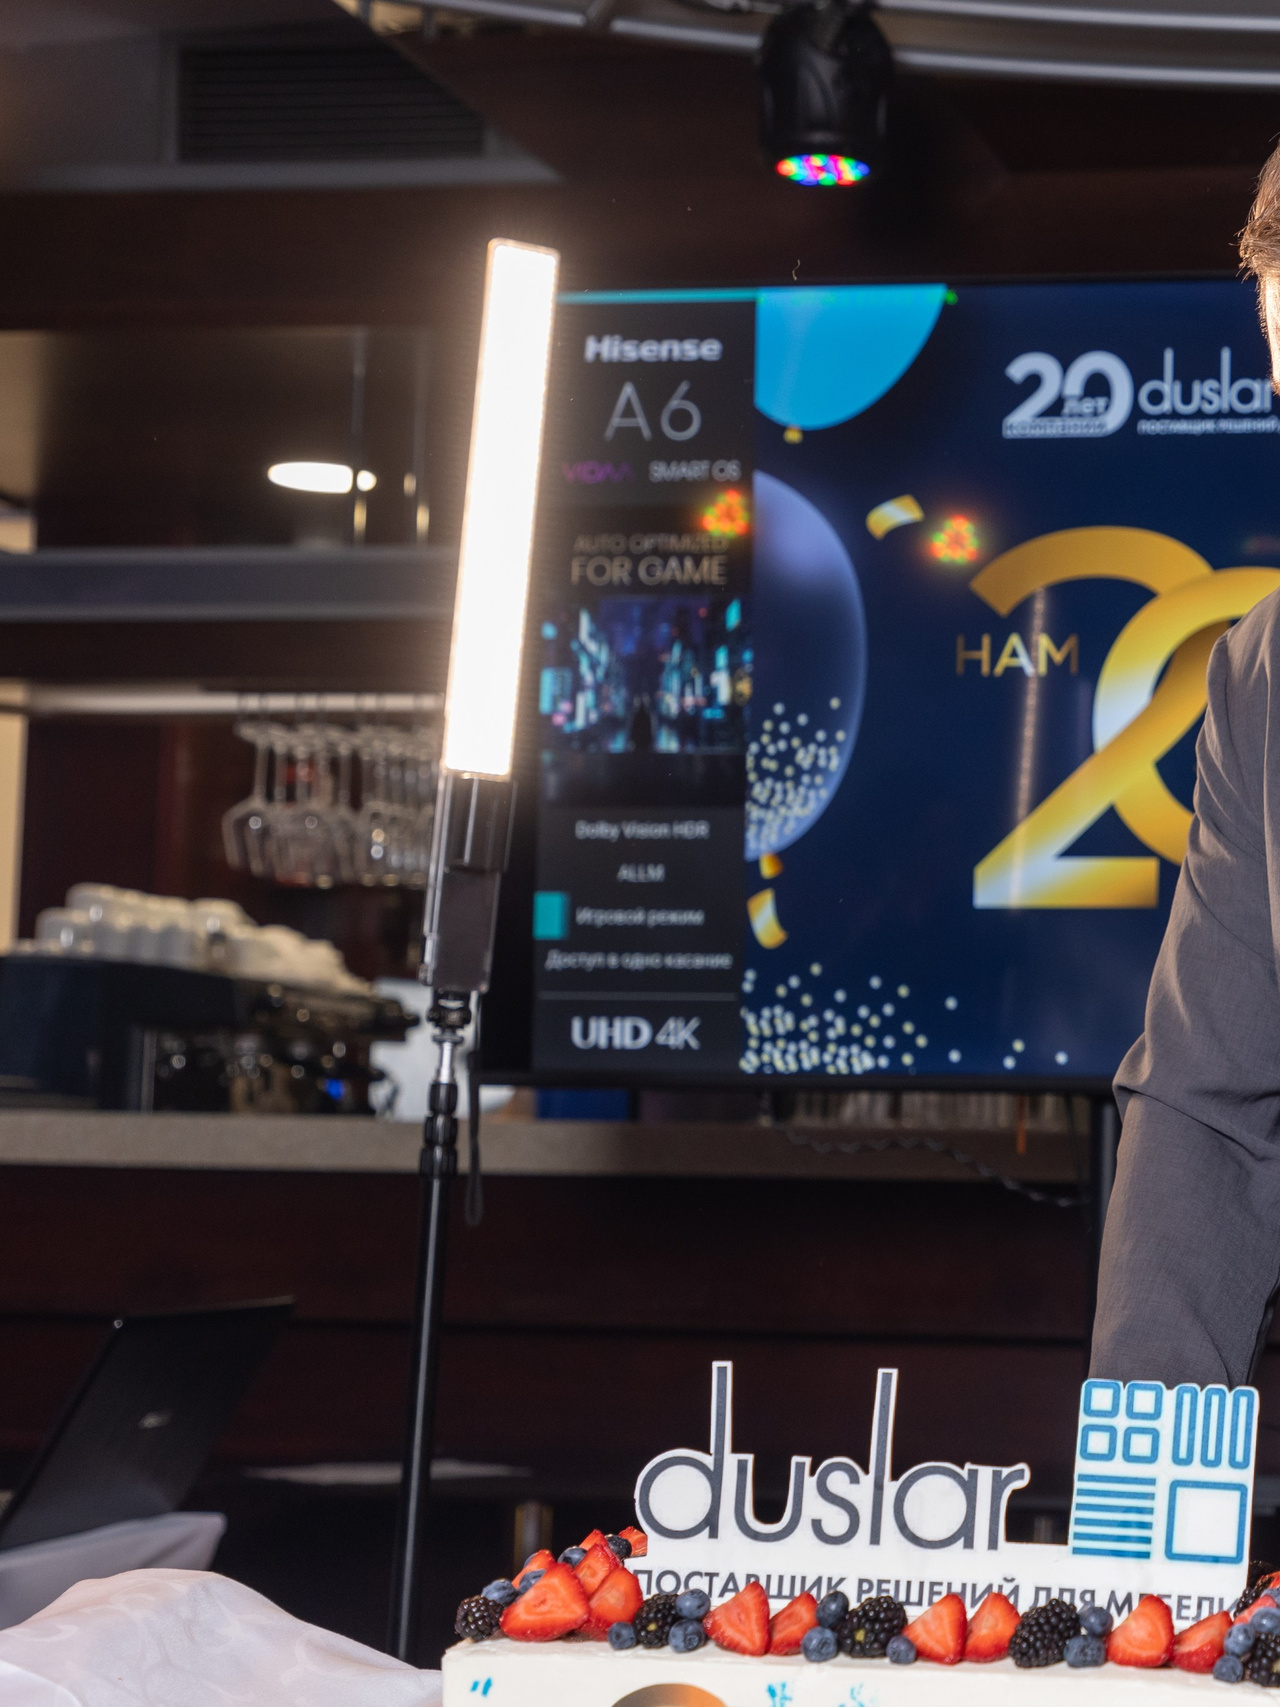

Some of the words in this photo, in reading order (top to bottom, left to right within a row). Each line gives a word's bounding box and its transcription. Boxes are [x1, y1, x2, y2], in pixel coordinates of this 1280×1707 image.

[585, 334, 723, 363] Hisense
[1004, 350, 1134, 439] 20
[1137, 347, 1274, 415] duslar
[604, 379, 702, 441] A6
[649, 459, 711, 482] SMART
[711, 459, 742, 482] OS
[573, 533, 627, 554] AUTO
[570, 555, 632, 585] FOR
[637, 555, 728, 585] GAME
[956, 633, 1079, 677] НАМ
[575, 820, 620, 842] Dolby
[620, 820, 671, 839] Vision
[672, 820, 711, 839] HDR
[616, 863, 665, 882] ALLM
[576, 906, 645, 929] Игровой
[647, 908, 705, 929] режим
[571, 1015, 653, 1050] UHD
[654, 1016, 701, 1050] 4K
[638, 1364, 1026, 1551] duslar
[1105, 1589, 1242, 1622] МЕЛ
